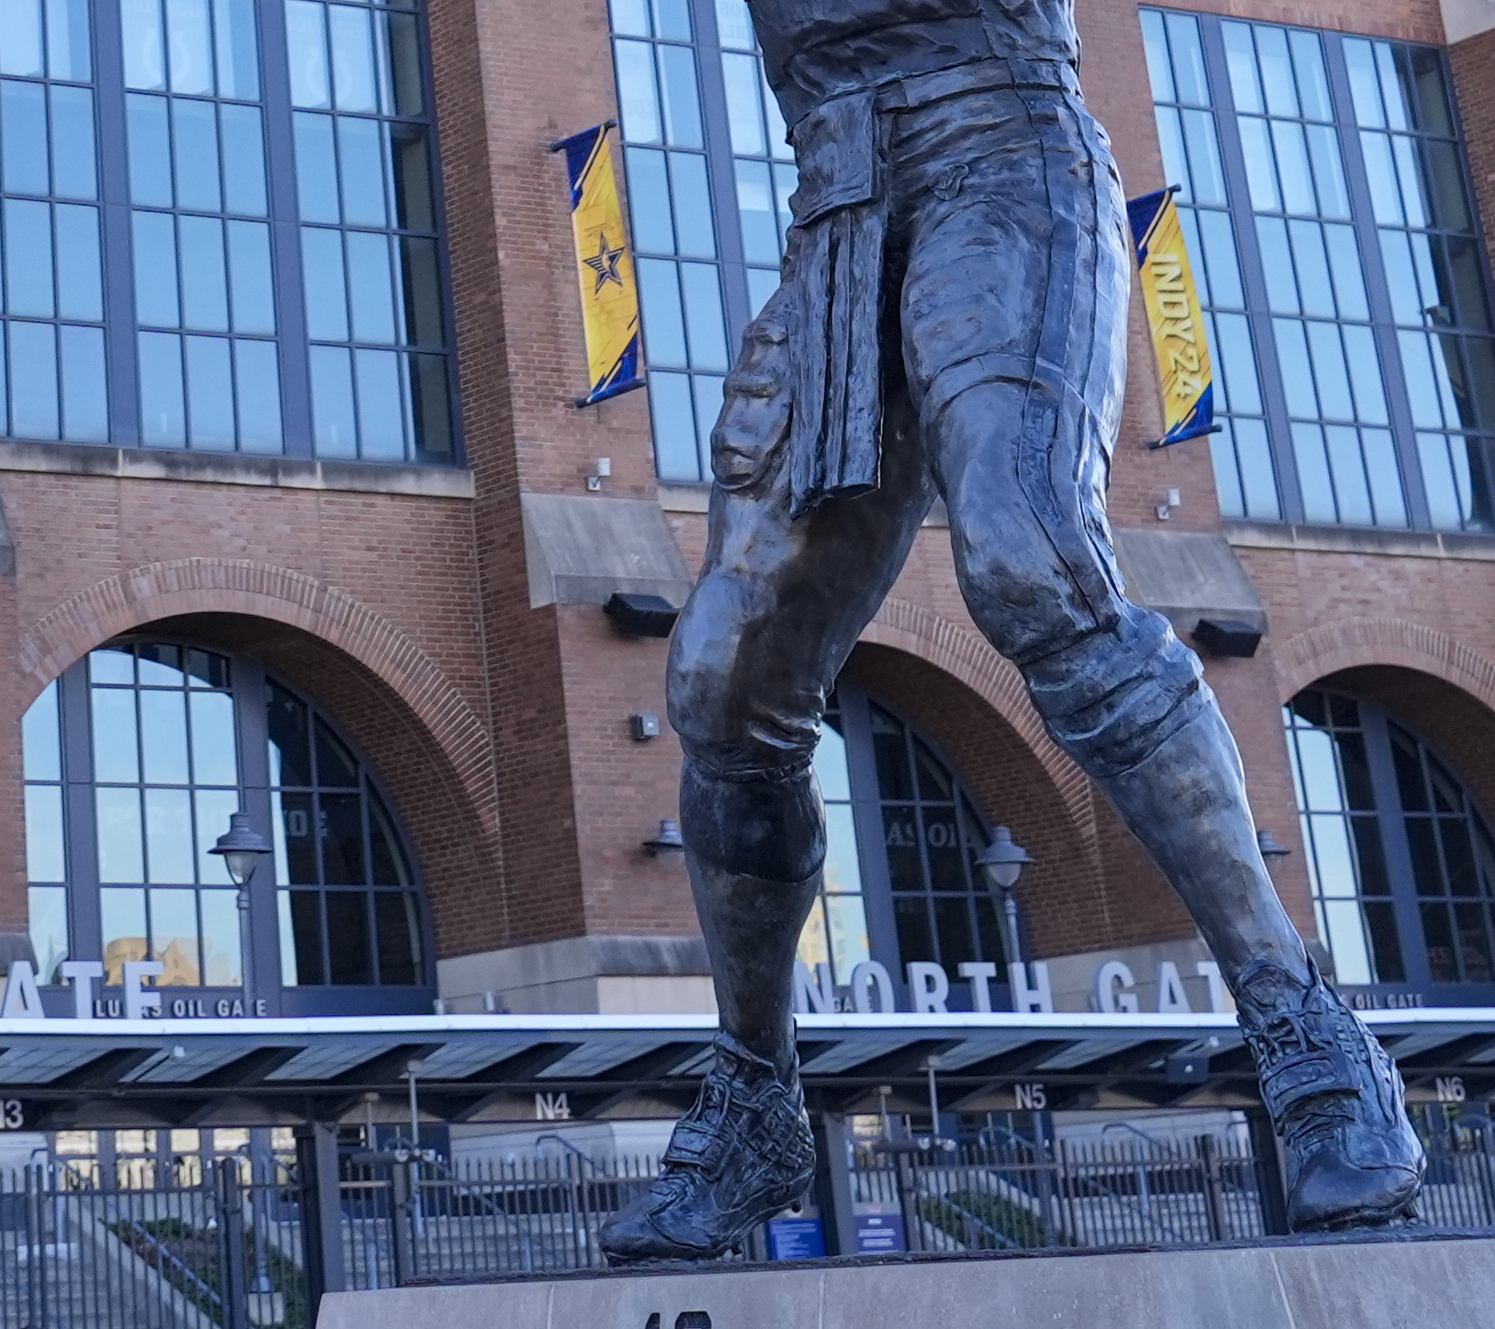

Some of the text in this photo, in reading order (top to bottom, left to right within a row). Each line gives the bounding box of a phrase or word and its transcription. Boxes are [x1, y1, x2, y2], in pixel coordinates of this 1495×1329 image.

[1150, 252, 1203, 400] INDY 24
[792, 959, 1226, 1015] NORTH GAT
[1354, 992, 1426, 1010] OIL GATE
[172, 998, 208, 1018] OIL
[216, 998, 268, 1018] GAE
[1013, 1082, 1047, 1111] N5
[1434, 1076, 1466, 1103] N6
[534, 1092, 571, 1120] N4
